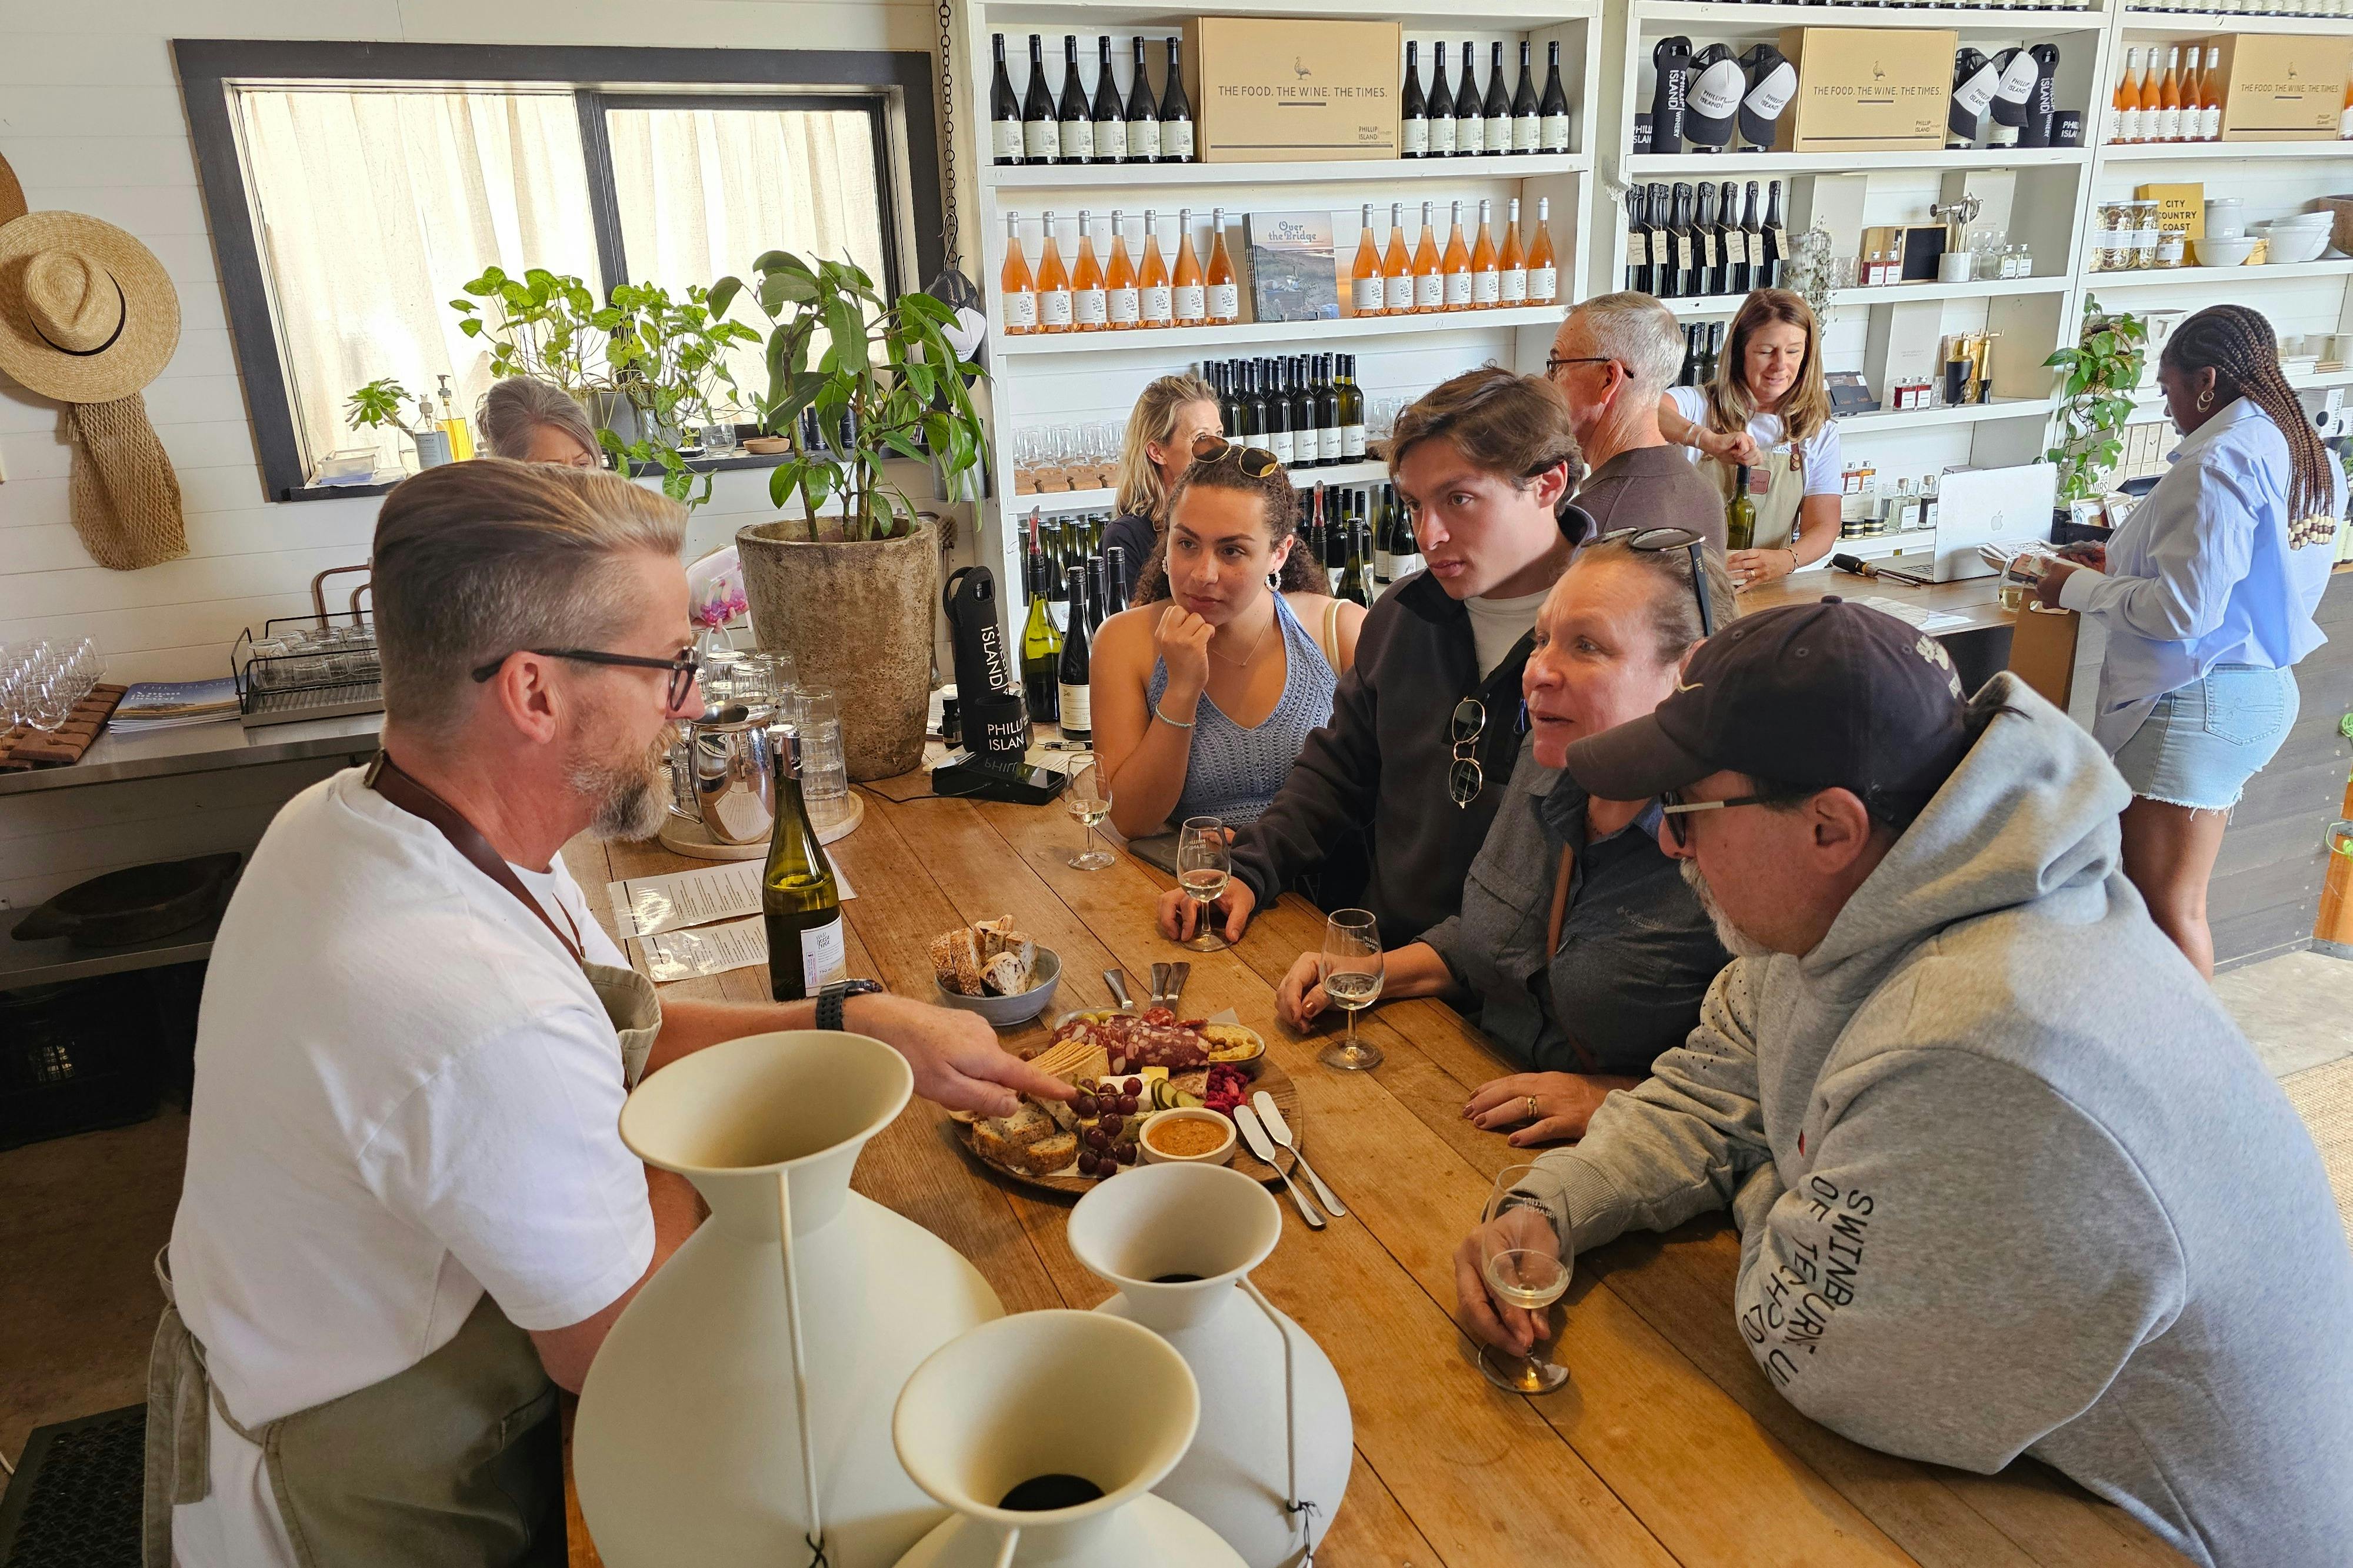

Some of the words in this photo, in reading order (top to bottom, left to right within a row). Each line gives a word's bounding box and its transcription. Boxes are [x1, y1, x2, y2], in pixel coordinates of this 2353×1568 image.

[1218, 86, 1238, 96] THE
[1242, 86, 1274, 96] FOOD.
[1277, 87, 1296, 96] THE
[1299, 87, 1330, 97] WINE.
[1334, 87, 1352, 97] THE
[1355, 88, 1388, 97] TIMES.
[1668, 70, 1679, 108] ISLAND
[1814, 86, 1829, 95] THE
[1831, 86, 1855, 95] FOOD.
[1858, 87, 1872, 95] THE
[1874, 87, 1898, 95] WINE.
[1901, 87, 1915, 95] THE
[1918, 87, 1942, 95] TIMES.
[2040, 78, 2050, 112] ISLAND
[1699, 96, 1721, 108] ISLAND
[2165, 200, 2186, 208] CITY
[1279, 221, 1304, 231] Over
[2163, 223, 2191, 231] COAST
[1268, 232, 1283, 241] the
[1284, 231, 1317, 242] Bridge
[2092, 482, 2108, 493] NIBS
[981, 626, 1003, 687] ISLAND
[989, 732, 1025, 750] ISLAN
[1810, 1176, 1839, 1222] OF
